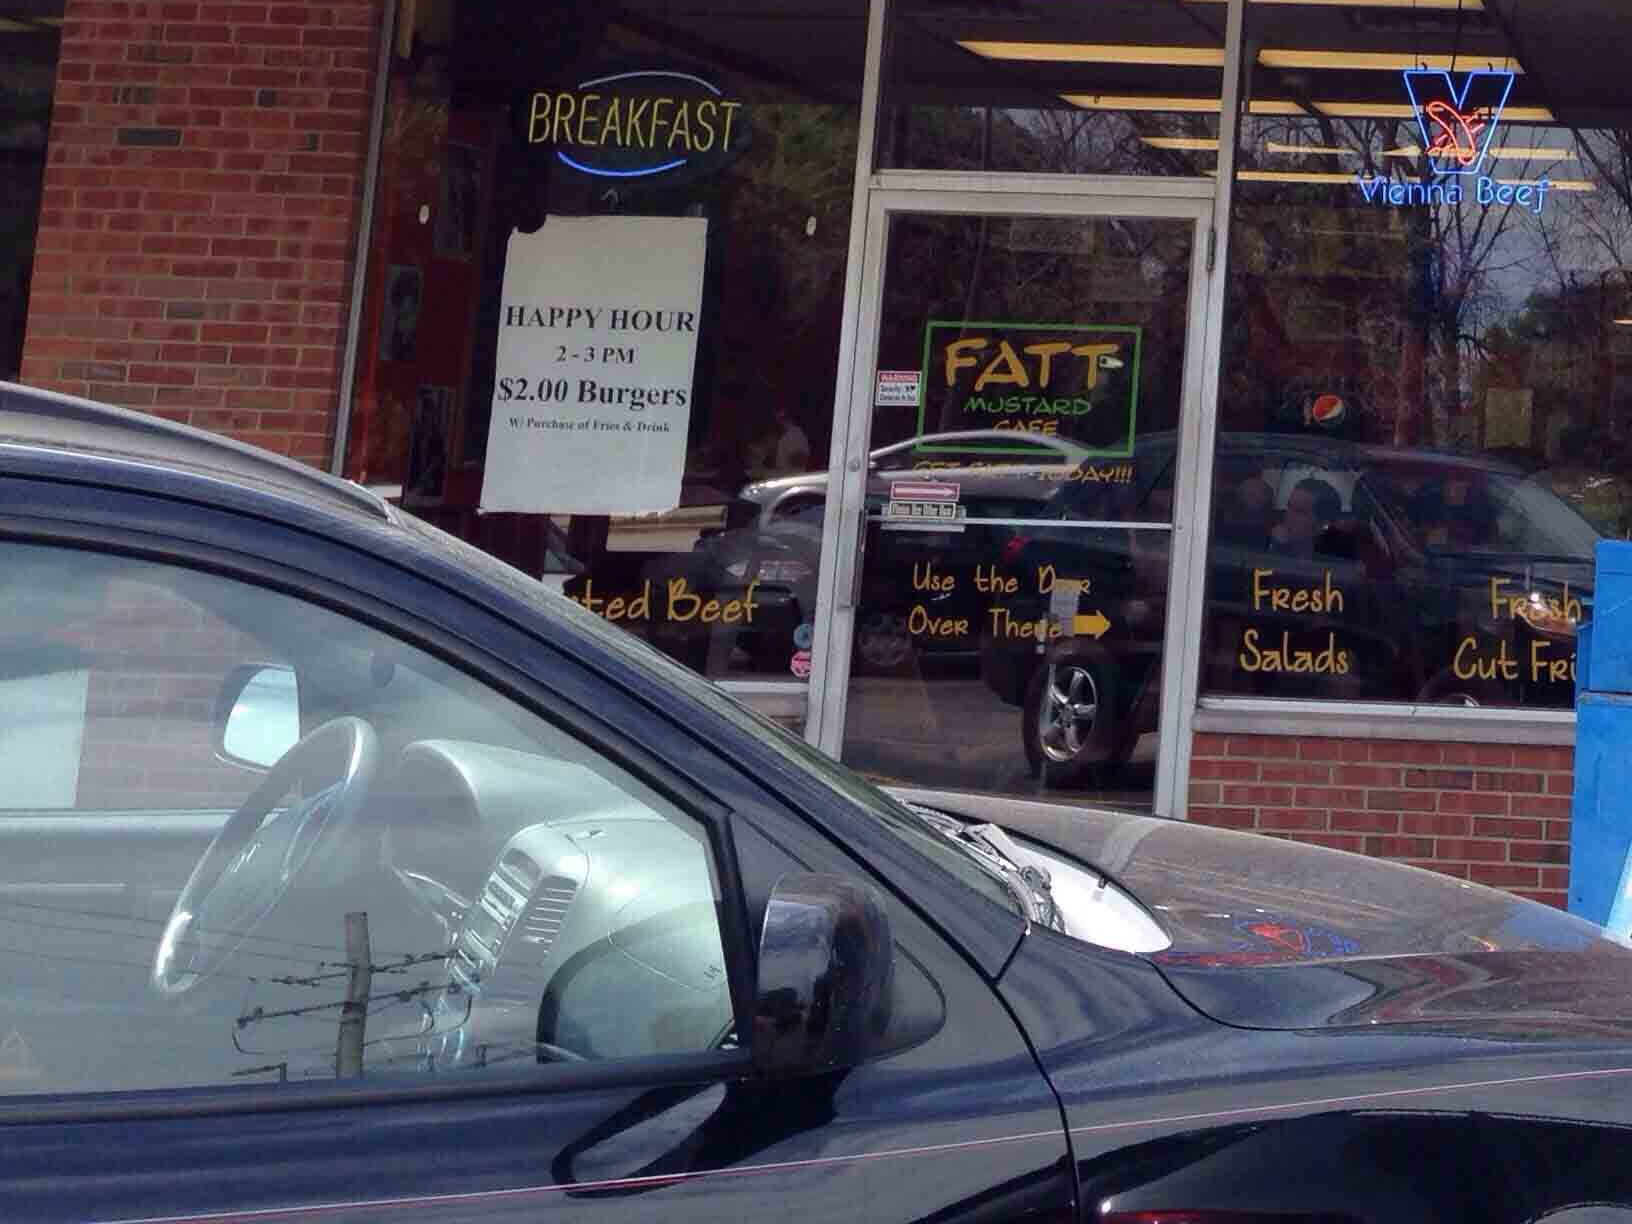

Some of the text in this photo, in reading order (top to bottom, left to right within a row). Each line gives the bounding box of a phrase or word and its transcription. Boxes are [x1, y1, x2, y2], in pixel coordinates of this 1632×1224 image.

[528, 91, 741, 153] BREAKFAST
[1359, 175, 1551, 214] Vienna Beef
[506, 305, 695, 332] HAPPY HOUR
[602, 347, 635, 364] PM
[944, 337, 1120, 393] FATT
[498, 377, 688, 411] $2.00 Burgers
[963, 396, 1092, 416] MUSTARD
[913, 561, 1092, 594] Use the Dr
[1252, 567, 1343, 613] Fresh
[1488, 575, 1582, 620] Fresh
[571, 577, 760, 623] ted Beef
[908, 604, 969, 637] Over
[1239, 628, 1349, 674] Salads
[1453, 637, 1577, 682] Cut Fri
